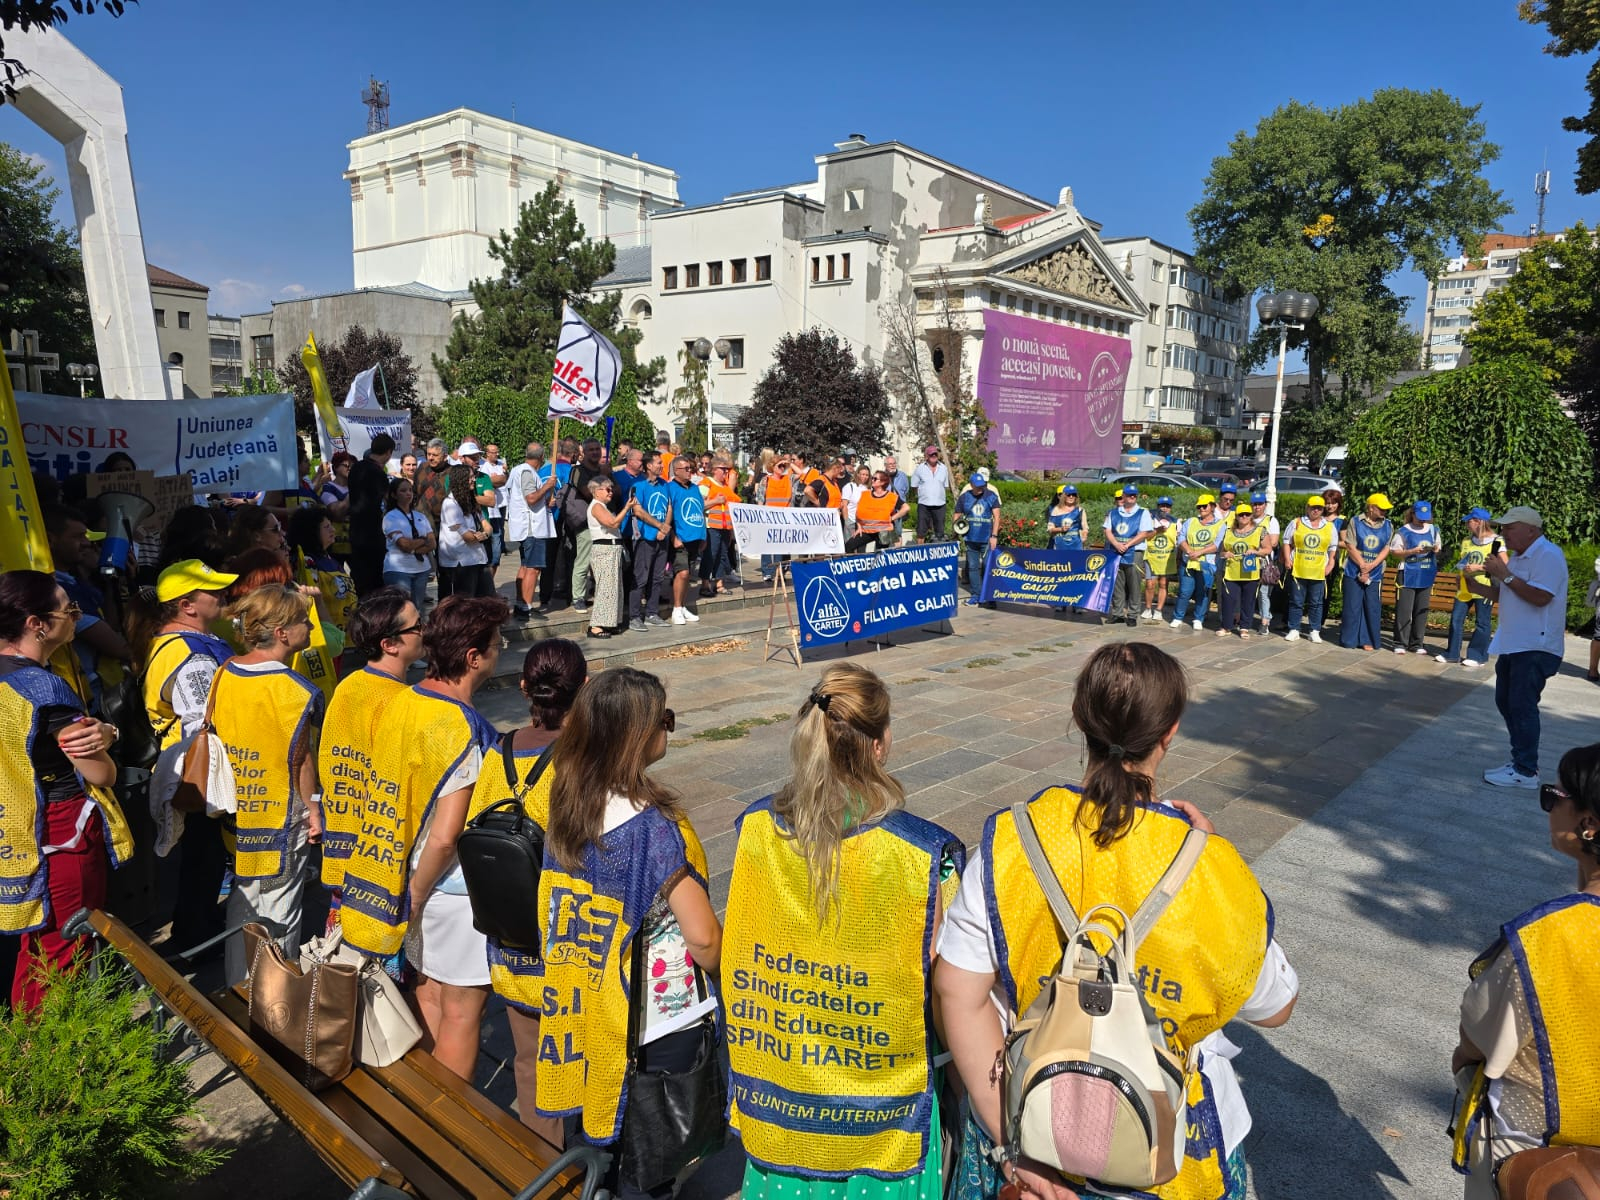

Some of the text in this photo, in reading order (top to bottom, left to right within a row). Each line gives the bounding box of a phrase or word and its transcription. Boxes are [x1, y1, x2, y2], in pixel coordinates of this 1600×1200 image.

[1002, 337, 1010, 351] o
[22, 422, 130, 449] CNSLR
[187, 416, 254, 434] Uniunea
[184, 434, 278, 462] Județeană
[186, 465, 240, 487] Galați
[733, 508, 837, 527] SINDICATUL NATIONAL
[766, 528, 809, 544] SELGROS
[1023, 560, 1071, 572] Sindicatul
[845, 564, 953, 596] "Cartel ALFA"
[817, 602, 841, 619] alfa
[864, 593, 955, 625] FILIALA GALATI
[815, 619, 844, 632] CARTEL
[753, 943, 869, 989] Federația
[733, 970, 884, 1017] Sindicatelor
[731, 999, 890, 1048] din Educație
[750, 1091, 814, 1119] SUNTEM
[819, 1103, 916, 1122] PUTERNICI!
